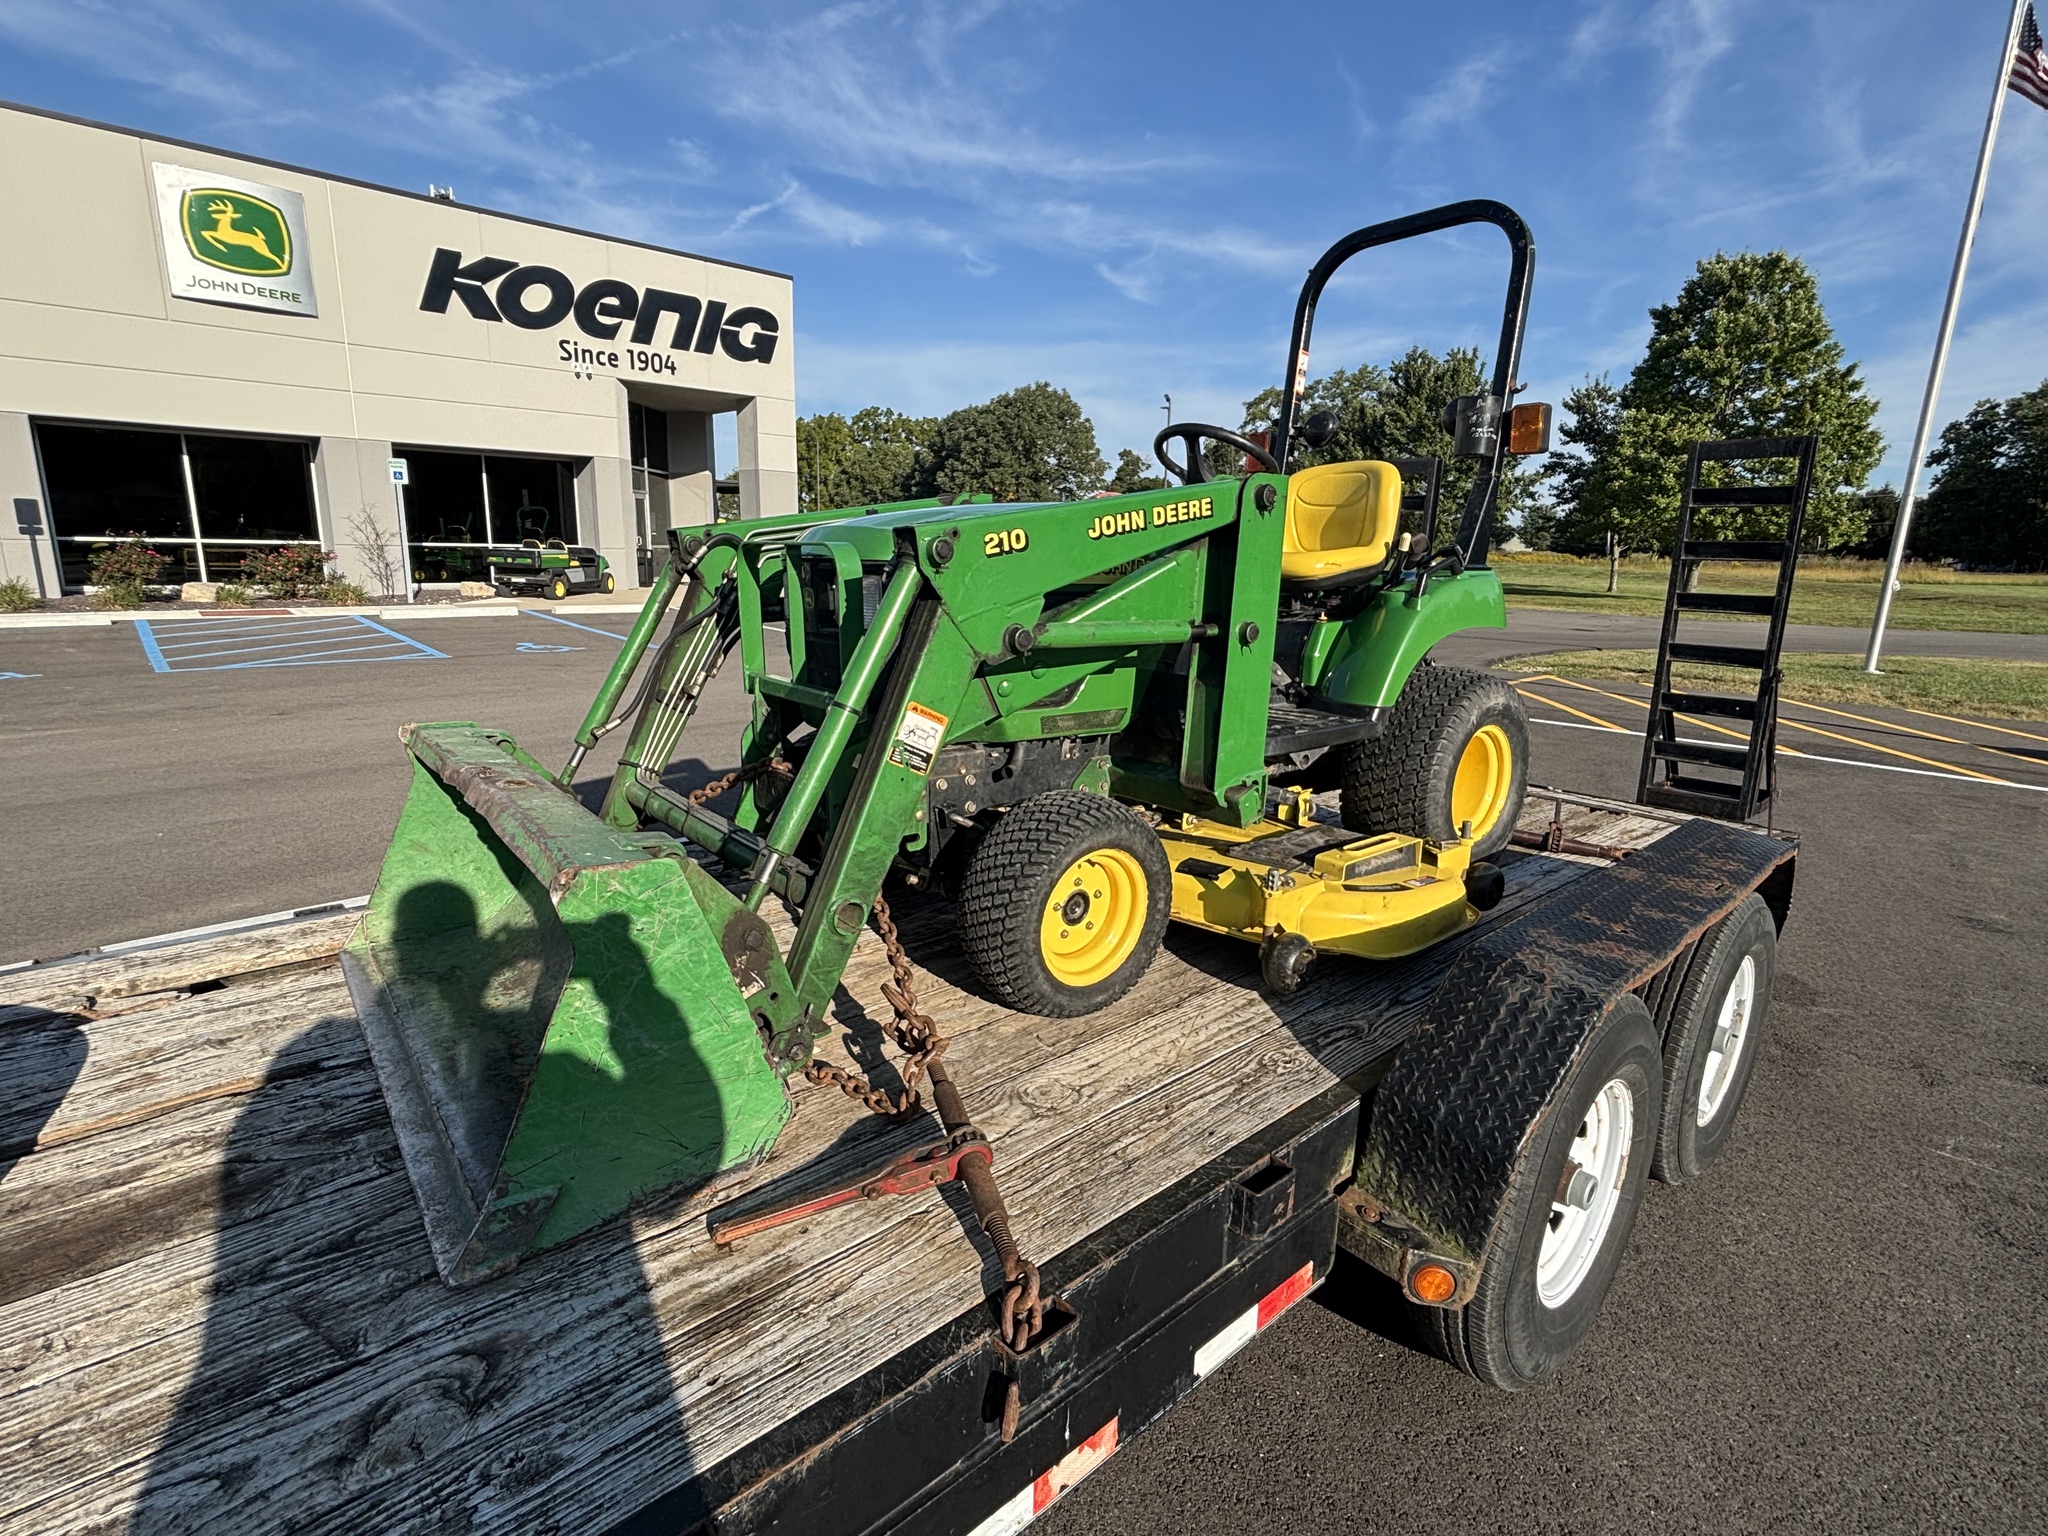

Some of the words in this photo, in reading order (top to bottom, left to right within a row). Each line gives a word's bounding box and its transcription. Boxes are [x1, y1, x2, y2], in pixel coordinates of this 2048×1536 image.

[185, 274, 239, 294] JOHN
[241, 281, 303, 304] DEERE
[558, 339, 620, 368] Since
[626, 348, 678, 376] 1904
[1088, 508, 1147, 540] JOHN
[1152, 496, 1213, 529] DEERE
[983, 528, 1029, 558] 210
